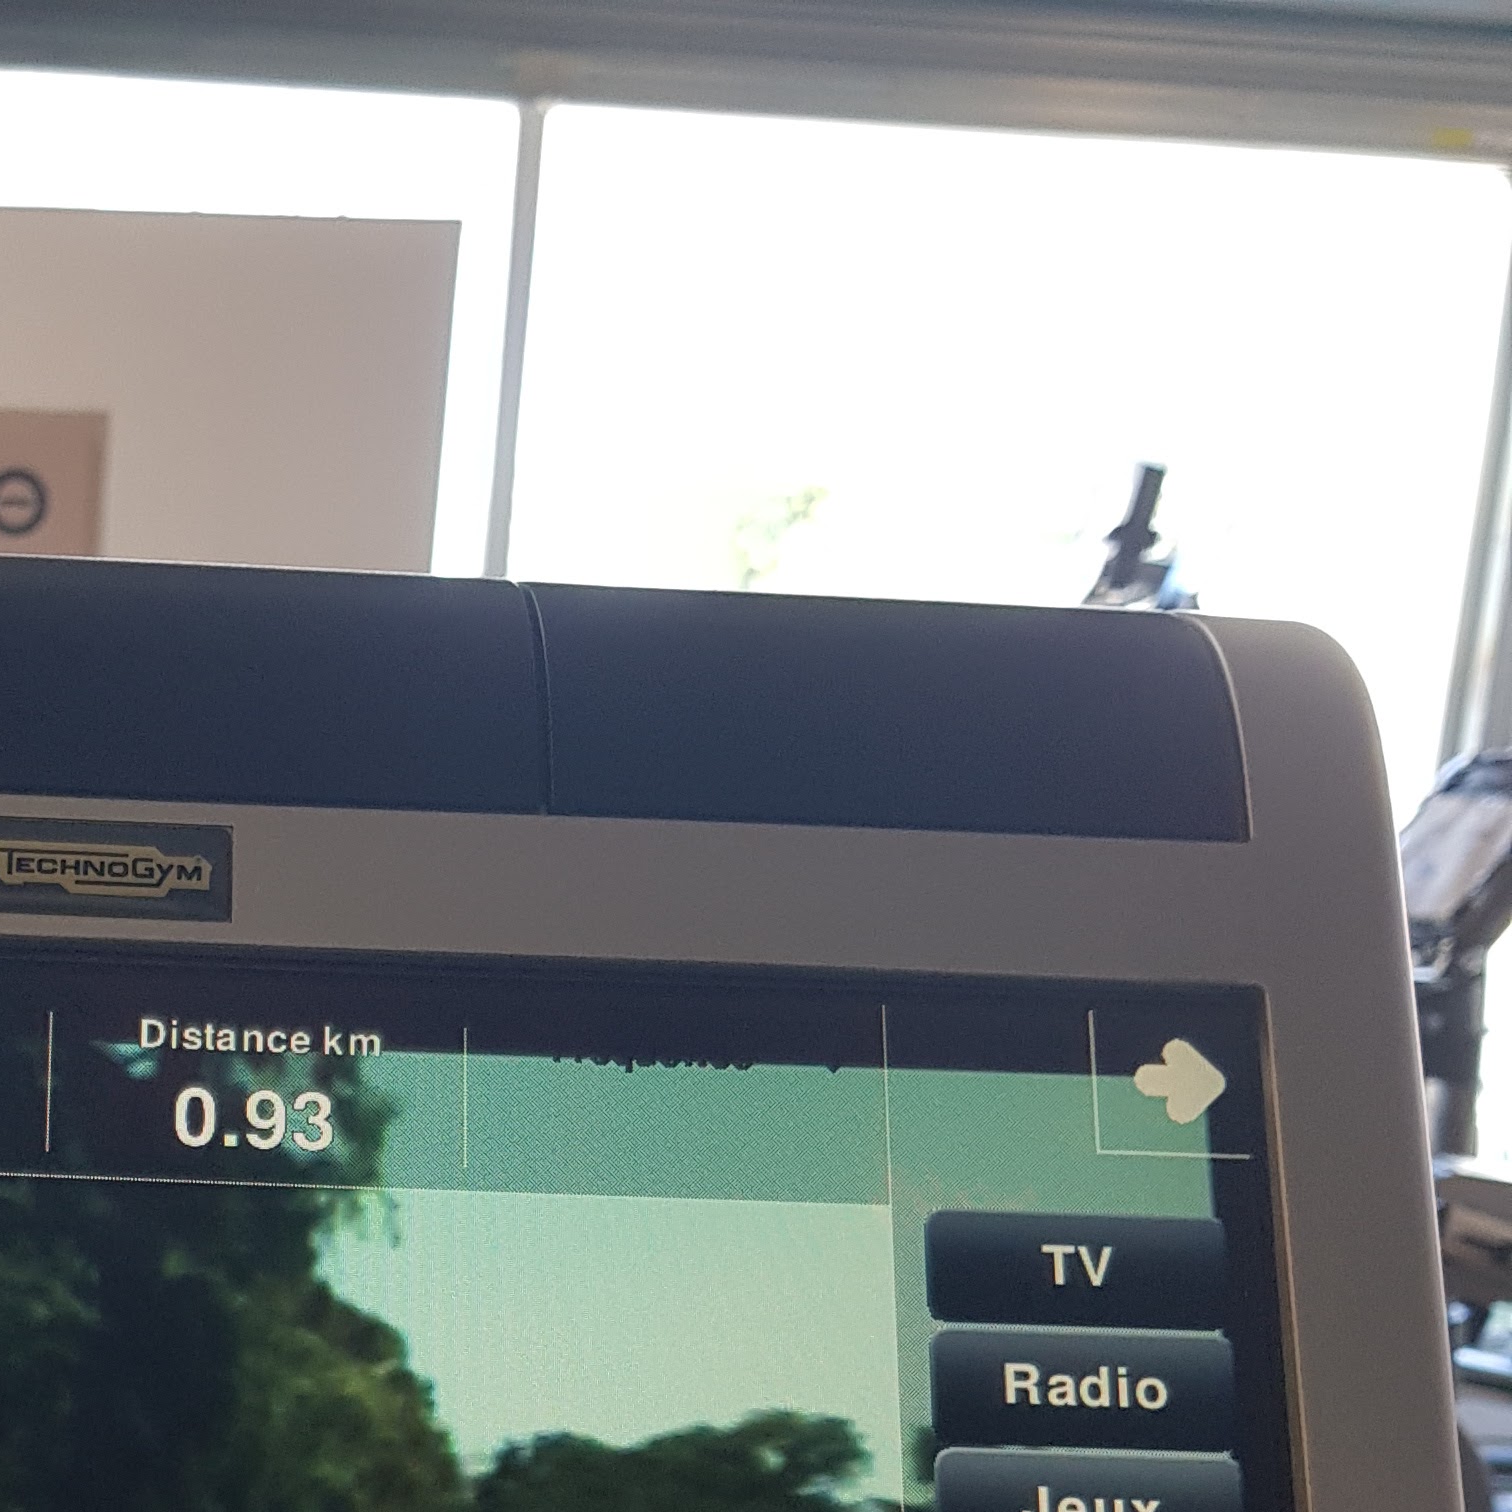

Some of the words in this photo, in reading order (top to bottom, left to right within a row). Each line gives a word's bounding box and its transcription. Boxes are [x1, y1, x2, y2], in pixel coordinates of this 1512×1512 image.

[139, 1018, 311, 1053] Distance
[323, 1026, 382, 1057] km
[174, 1086, 336, 1151] 0.93
[1040, 1243, 1114, 1287] TV
[1003, 1362, 1169, 1411] Radio
